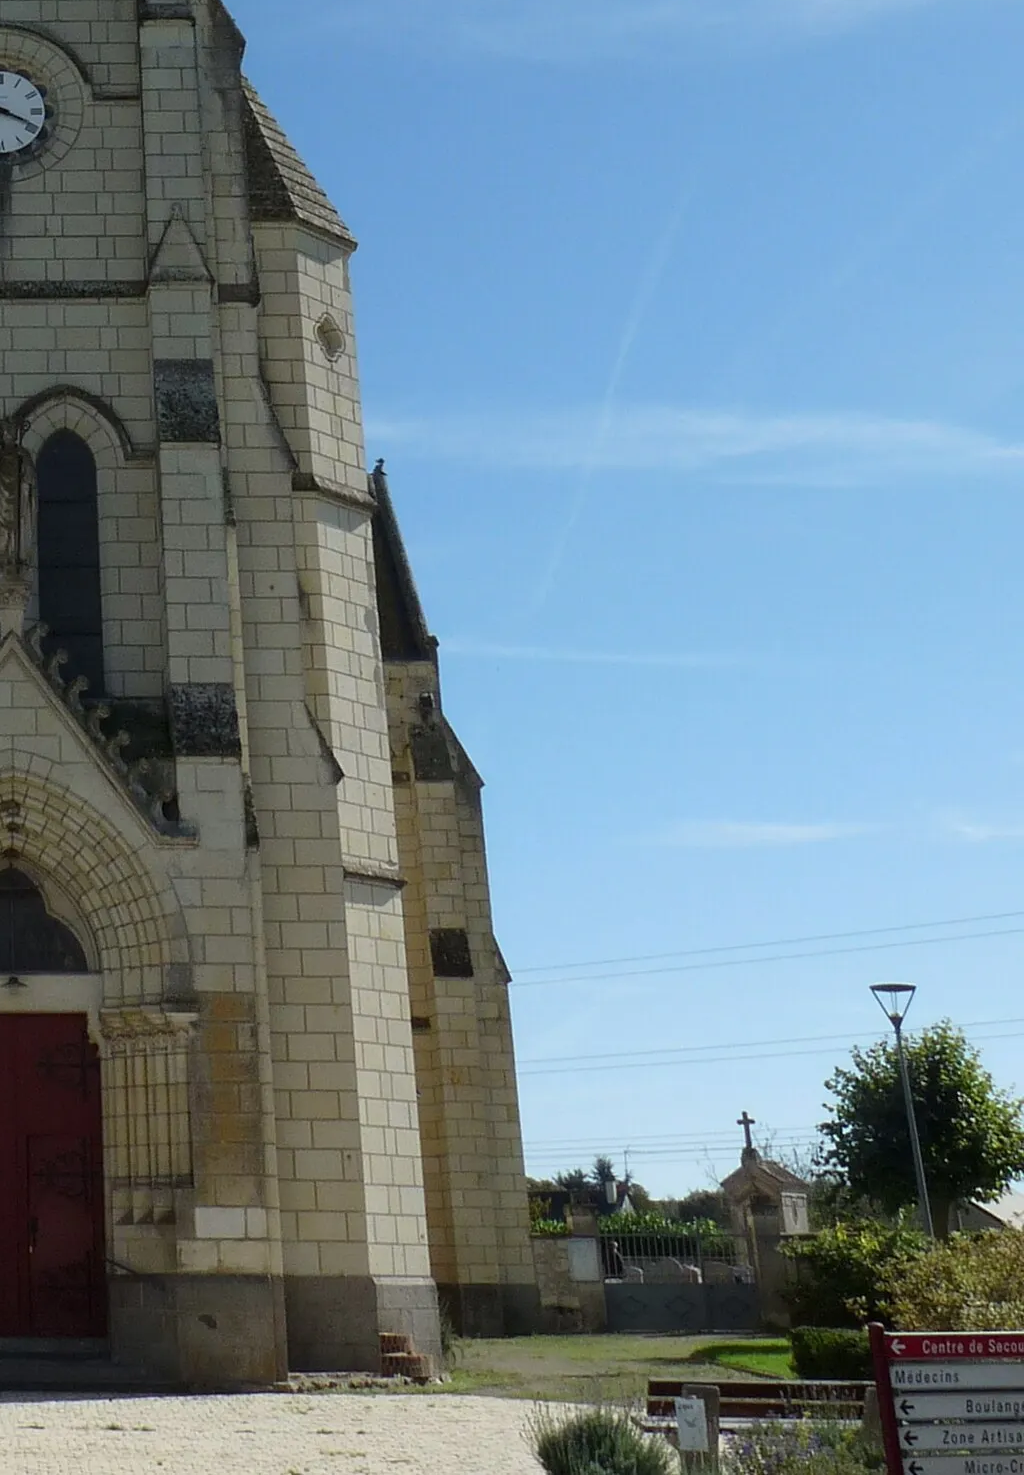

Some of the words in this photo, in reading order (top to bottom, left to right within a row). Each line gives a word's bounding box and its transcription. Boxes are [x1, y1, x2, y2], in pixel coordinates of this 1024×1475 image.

[922, 1339, 964, 1354] Centre
[969, 1339, 984, 1354] de
[894, 1369, 959, 1384] Médecins
[943, 1430, 975, 1445] Zone
